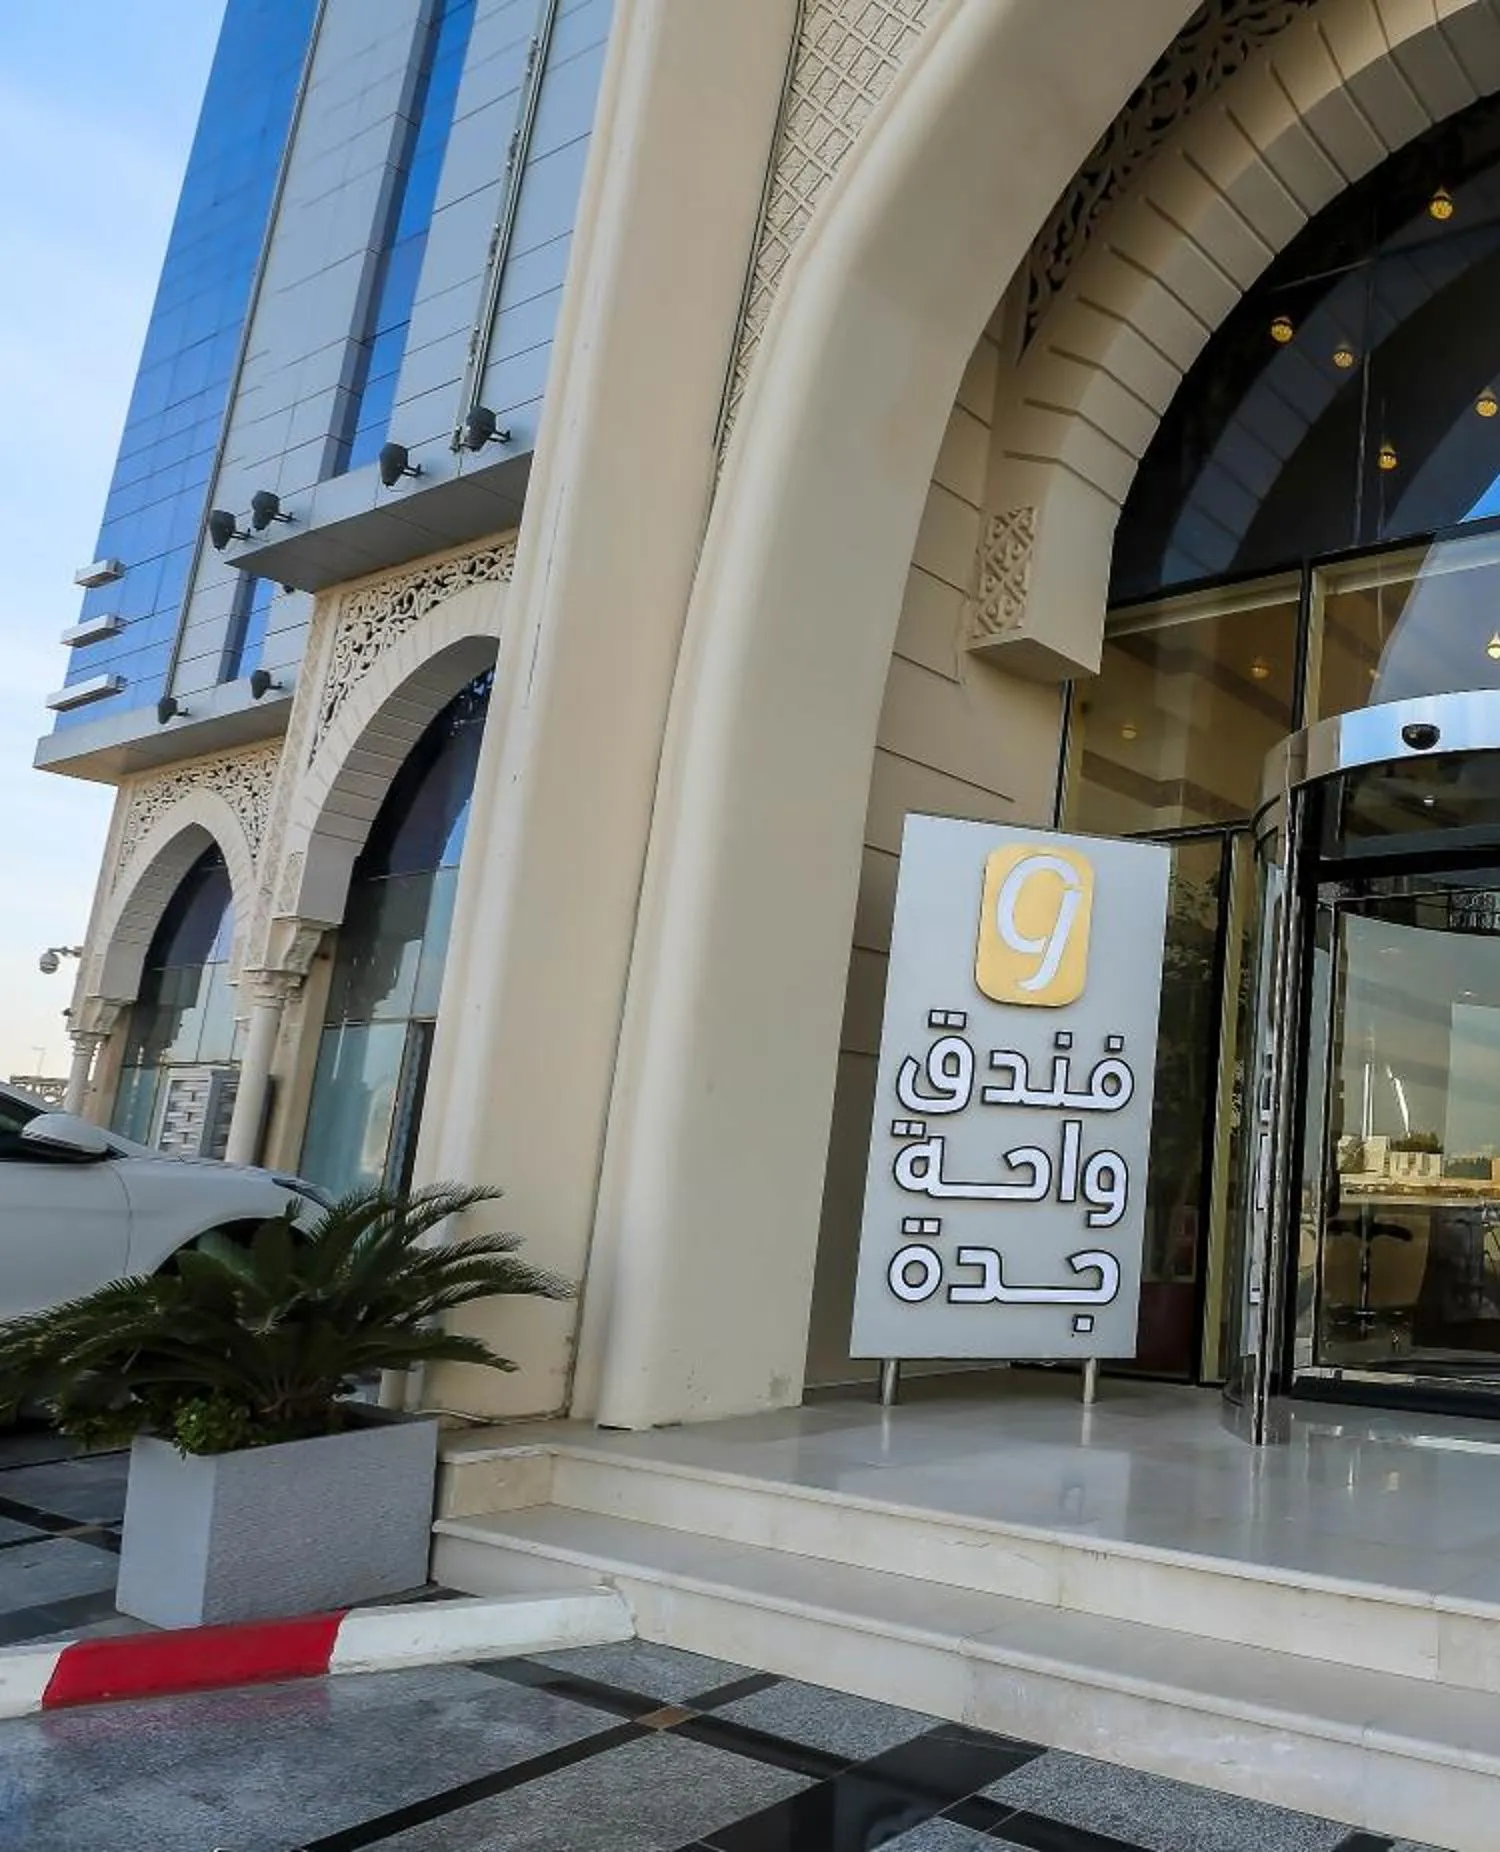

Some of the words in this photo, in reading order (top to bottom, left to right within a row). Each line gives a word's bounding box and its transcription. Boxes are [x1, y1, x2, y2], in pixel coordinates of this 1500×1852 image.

[896, 1010, 1136, 1114] فندق
[891, 1119, 1130, 1228] واحة
[887, 1217, 1121, 1333] جدة
